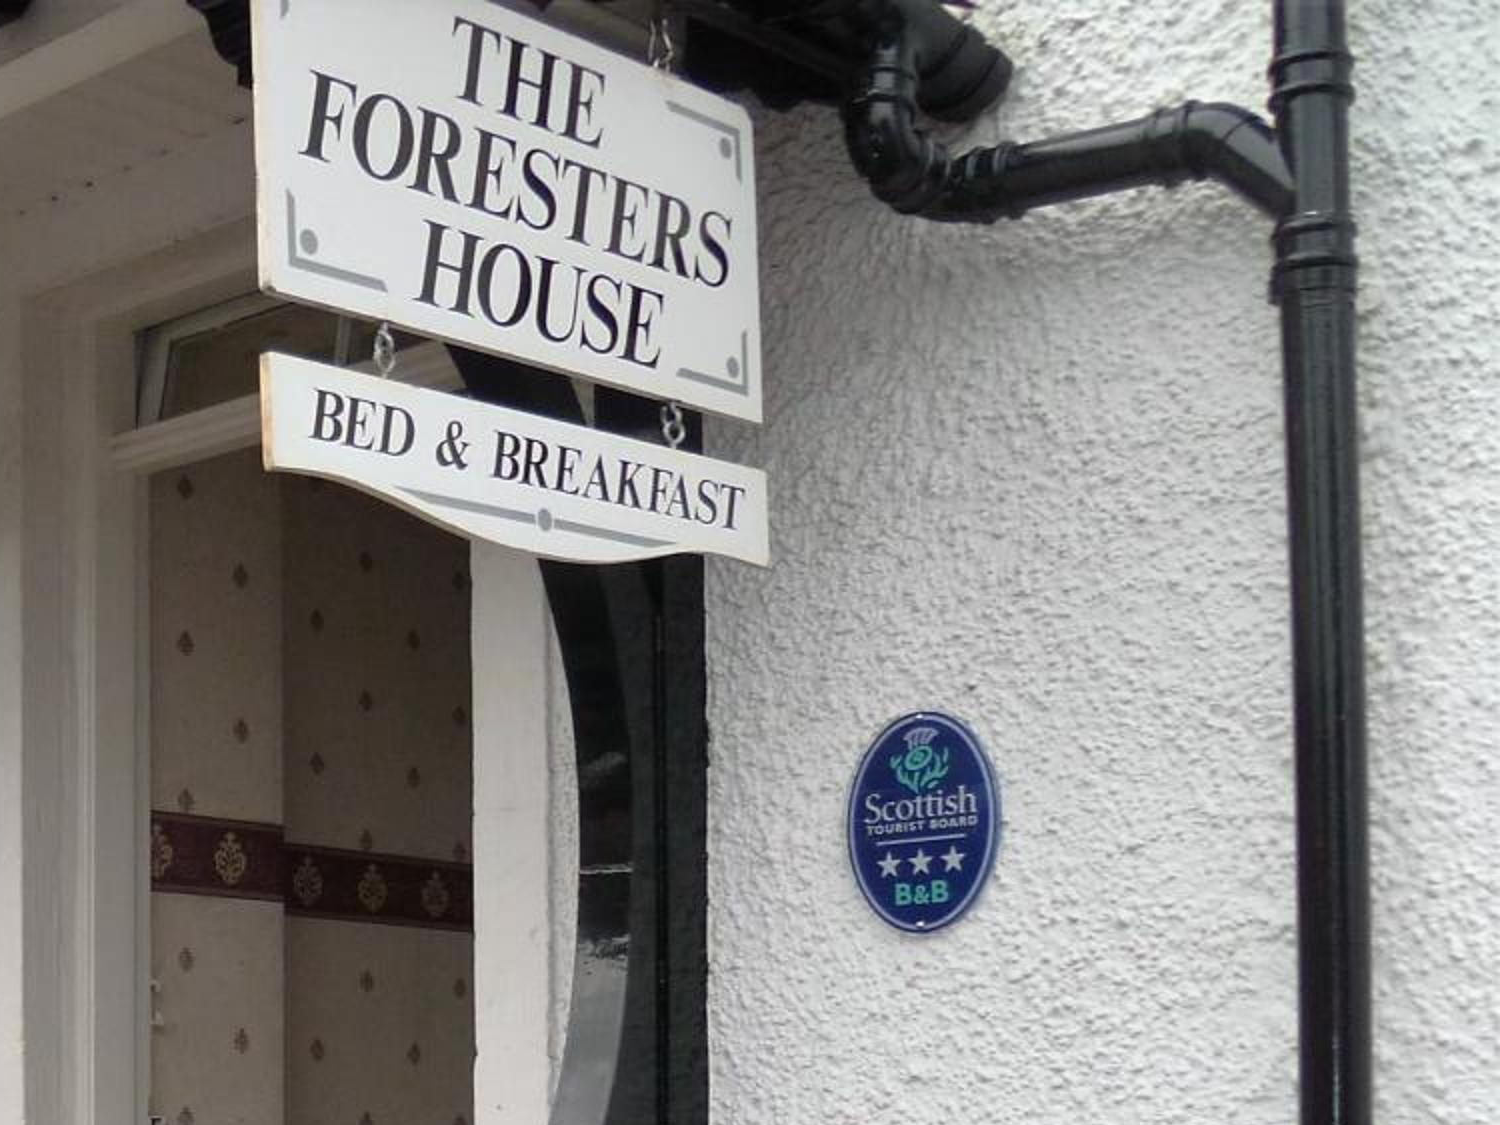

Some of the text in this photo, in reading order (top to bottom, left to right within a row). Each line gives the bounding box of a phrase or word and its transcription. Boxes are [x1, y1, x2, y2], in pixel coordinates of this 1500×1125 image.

[453, 16, 606, 150] THE
[297, 69, 733, 289] FORESTERS
[412, 219, 665, 370] HOUSE
[308, 389, 746, 532] BED & BREAKFAST
[864, 785, 978, 824] Scottish
[866, 815, 979, 836] TOURIST BOARD
[894, 880, 949, 906] B&B
